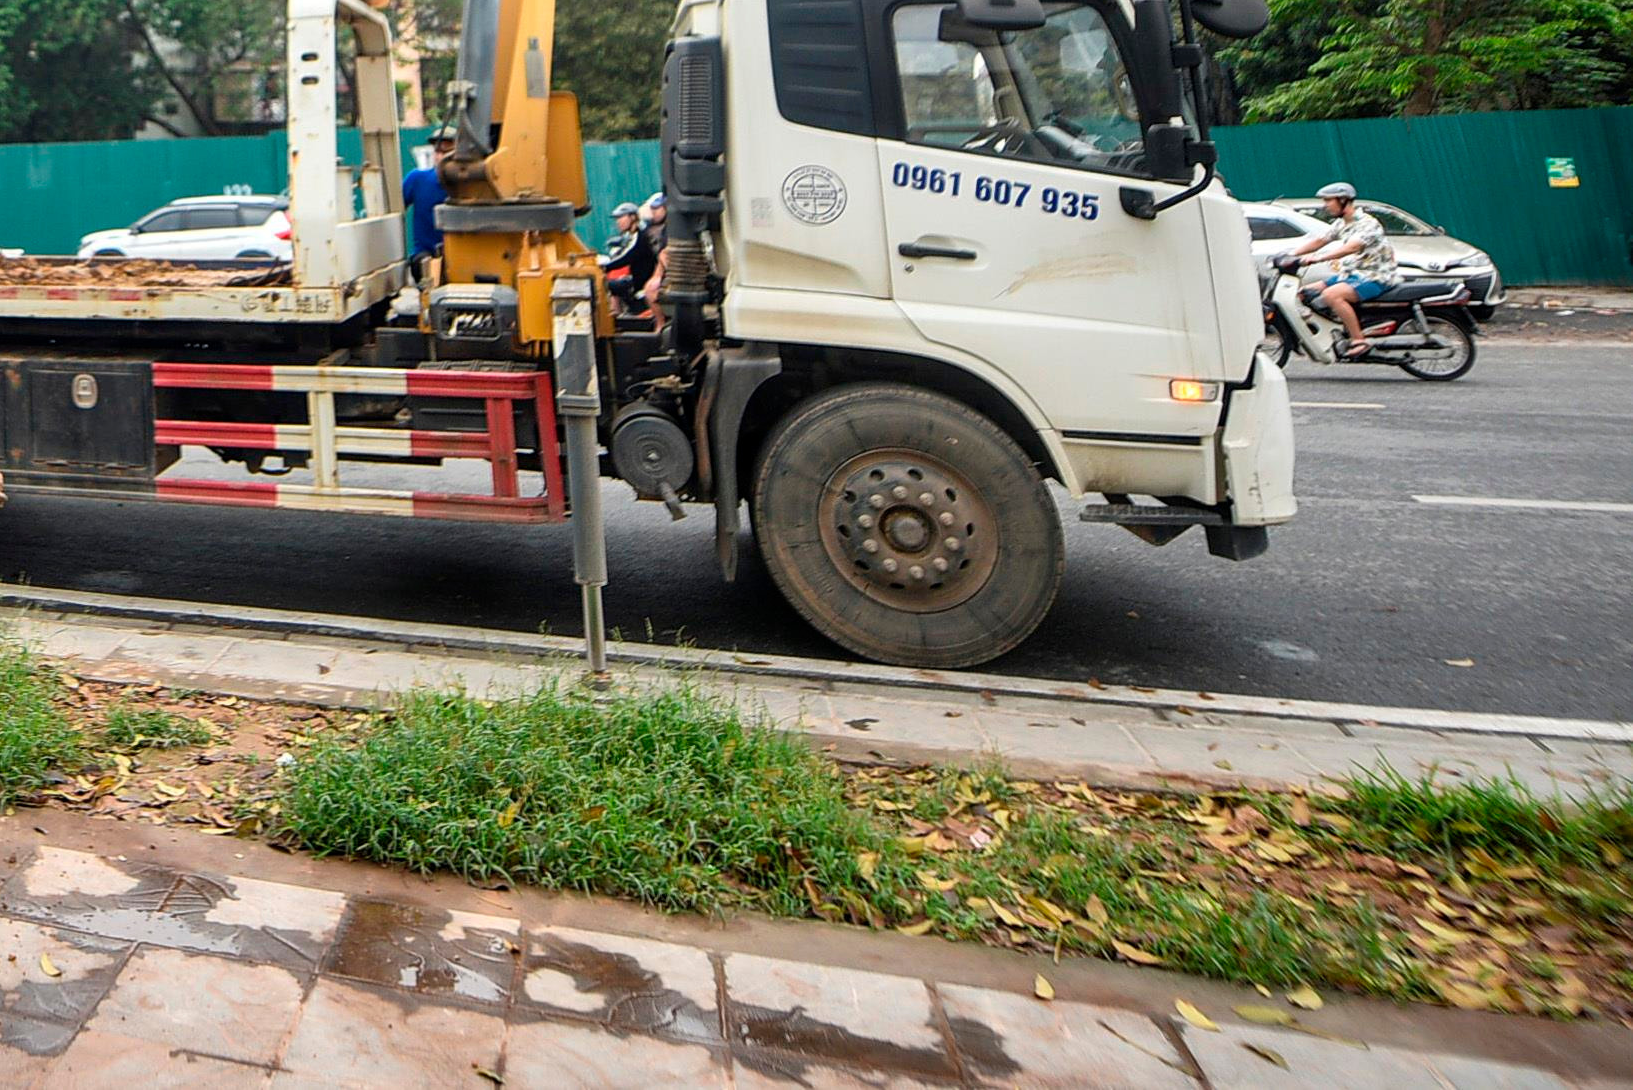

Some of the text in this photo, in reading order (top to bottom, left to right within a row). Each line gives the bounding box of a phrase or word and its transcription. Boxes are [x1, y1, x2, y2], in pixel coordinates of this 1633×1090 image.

[892, 162, 1099, 221] 0961 607 935
